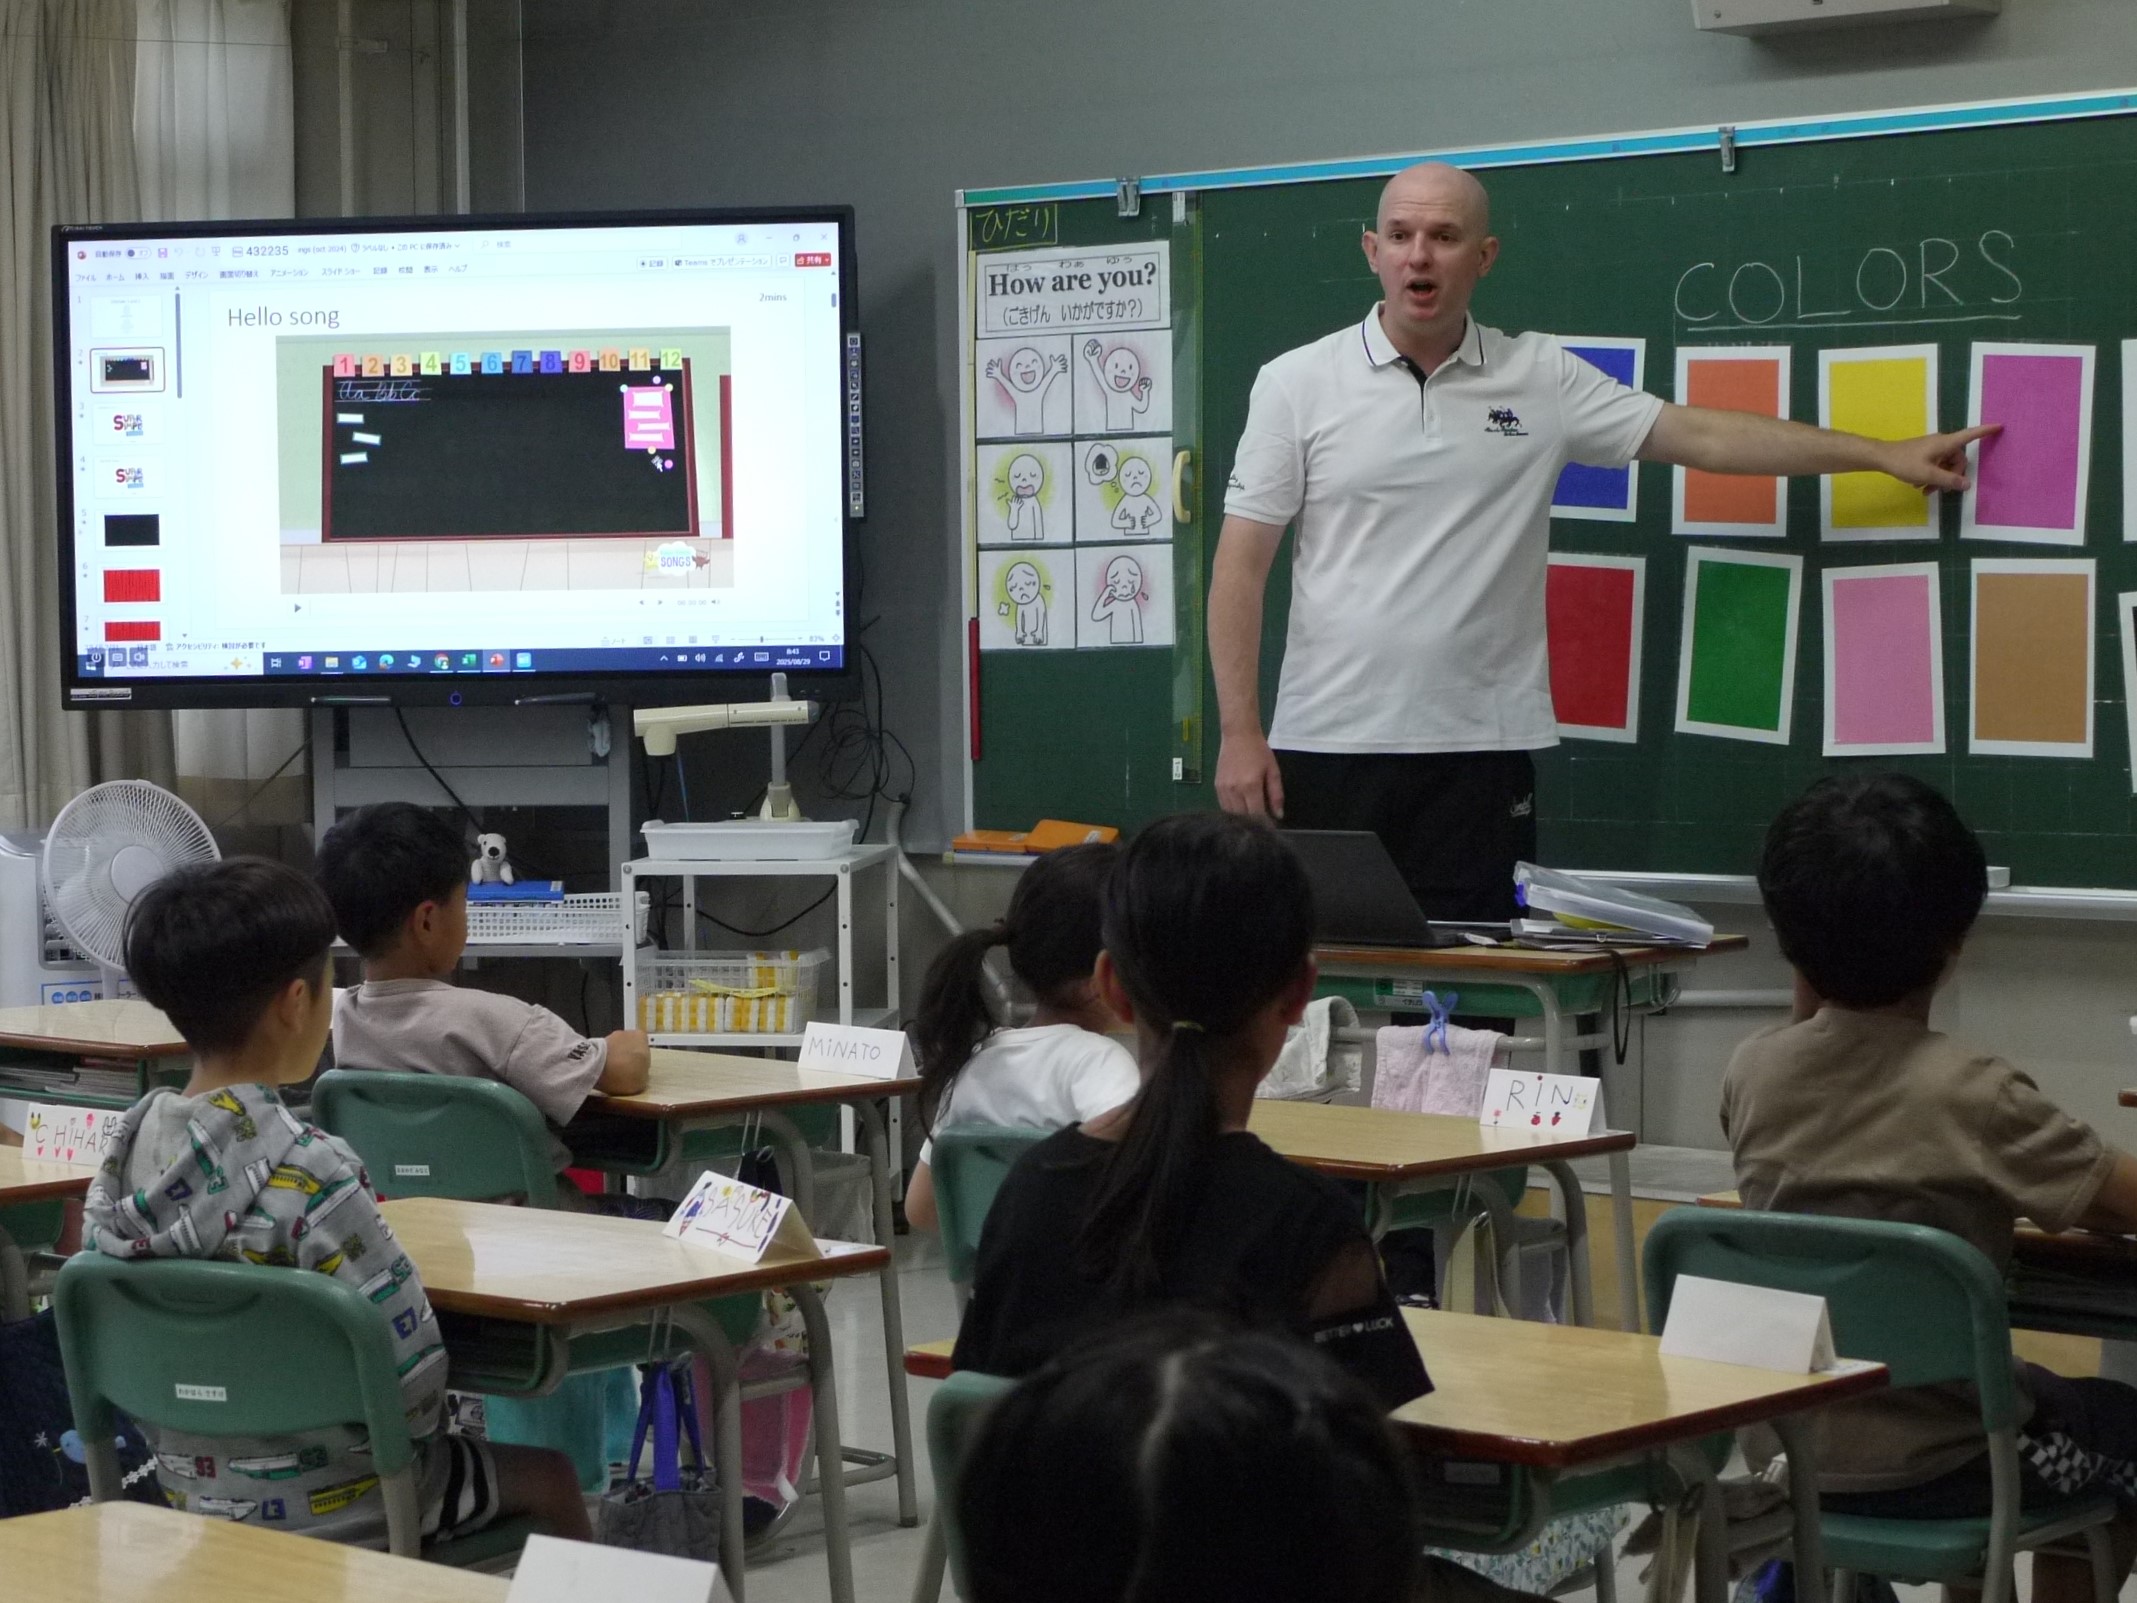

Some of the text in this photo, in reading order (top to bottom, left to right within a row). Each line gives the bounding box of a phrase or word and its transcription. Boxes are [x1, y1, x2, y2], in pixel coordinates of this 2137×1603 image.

[976, 209, 1050, 243] ひだり
[246, 246, 289, 257] 432235
[684, 258, 709, 266] Teams
[988, 261, 1157, 297] How are you?
[1674, 230, 2022, 324] COLORS
[759, 293, 787, 302] 2mins
[227, 306, 340, 330] Hello song
[1003, 299, 1143, 327] (ごきげん いかがですか?)
[340, 352, 681, 374] 1 2 3 4 5 6 7 8 9 10 11 12
[660, 556, 691, 568] SONGS
[391, 1306, 419, 1340] E7
